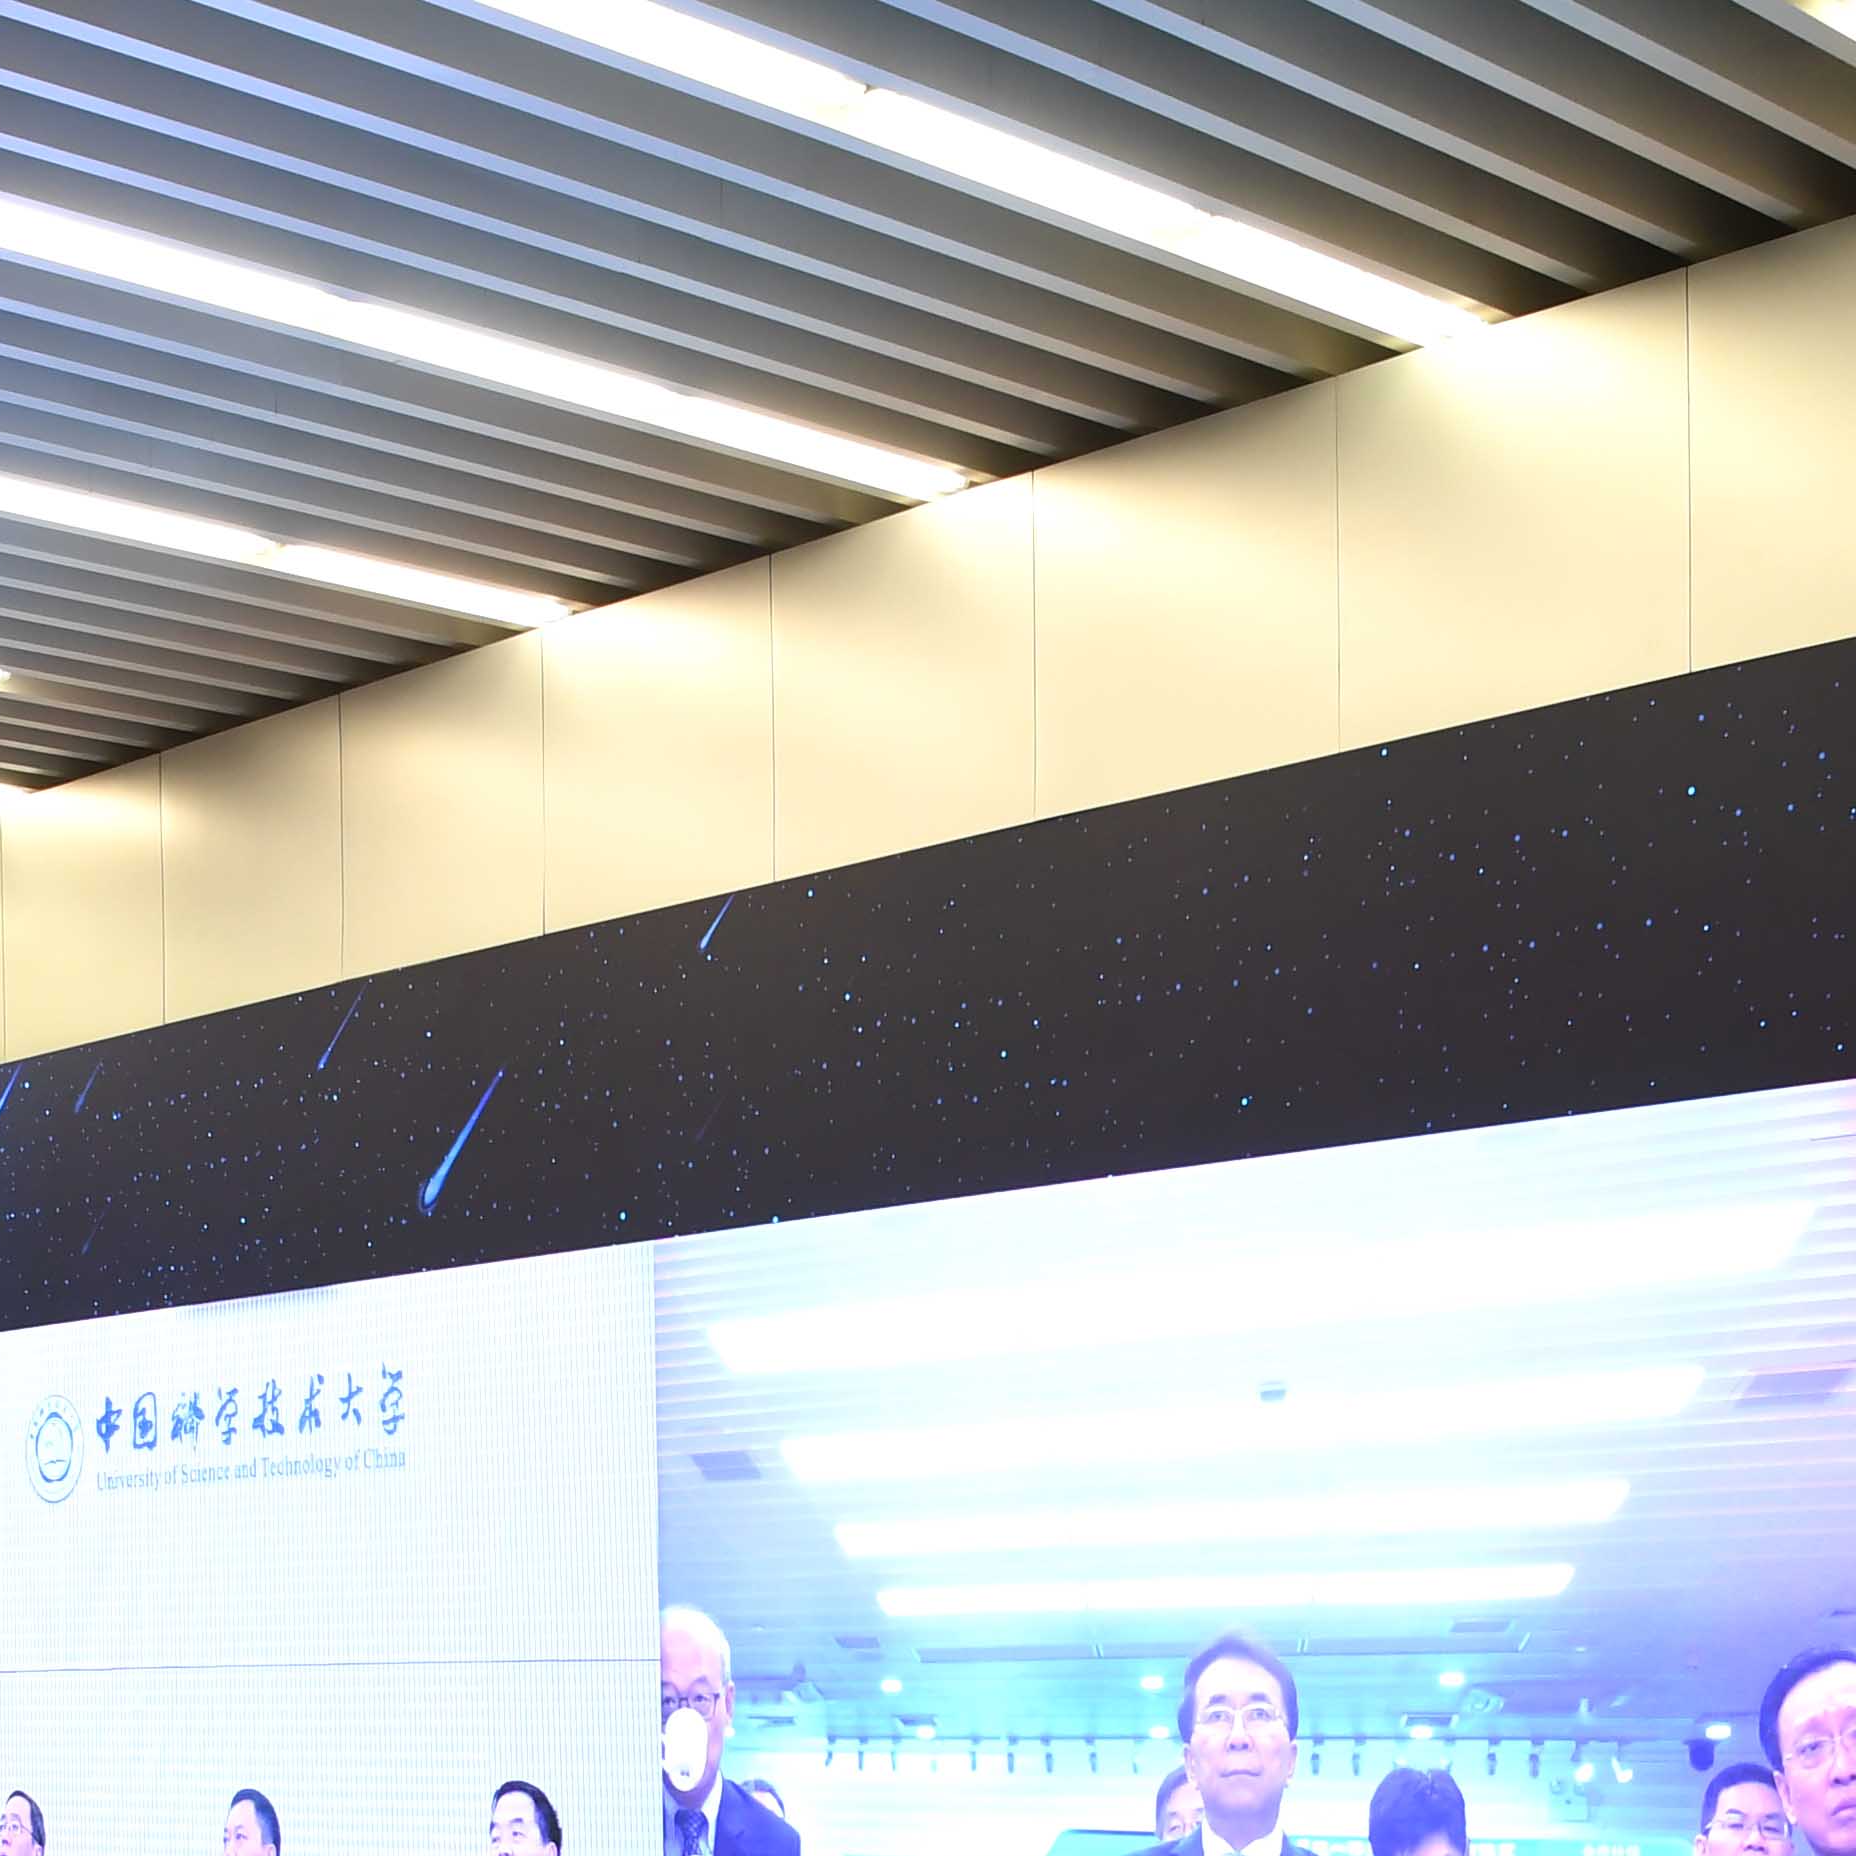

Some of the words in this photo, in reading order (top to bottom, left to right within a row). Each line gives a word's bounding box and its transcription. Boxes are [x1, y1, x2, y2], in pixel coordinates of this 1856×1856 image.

[95, 1361, 407, 1454] 中国科学技术大学
[97, 1470, 161, 1492] University
[164, 1467, 179, 1486] of
[180, 1463, 232, 1484] Science
[234, 1458, 258, 1479] and
[261, 1453, 341, 1480] Technology
[344, 1448, 361, 1471] of
[363, 1446, 407, 1470] China
